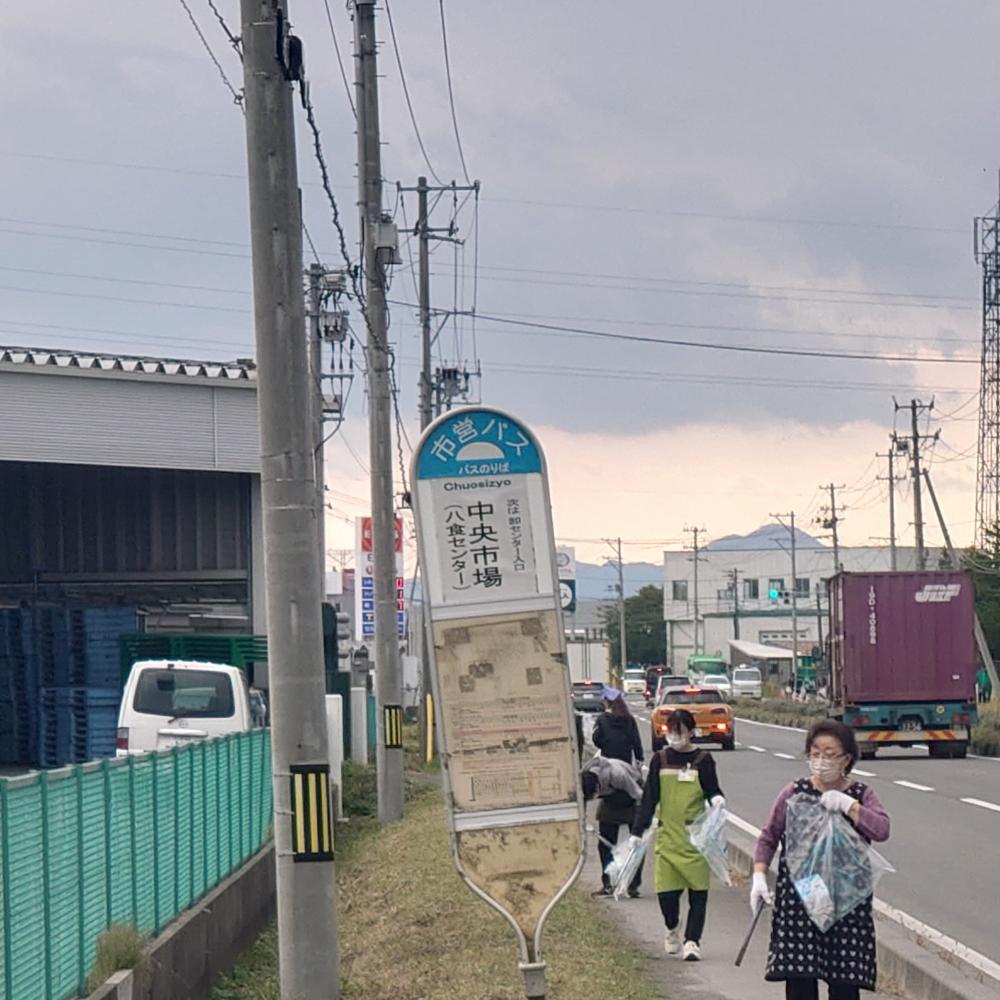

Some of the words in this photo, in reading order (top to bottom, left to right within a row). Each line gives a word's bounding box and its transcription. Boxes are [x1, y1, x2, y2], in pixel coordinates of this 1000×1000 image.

[431, 416, 529, 462] 市営バス
[458, 462, 510, 475] バスのりば
[443, 478, 512, 492] Chuosizyo
[467, 501, 503, 588] 中央市場
